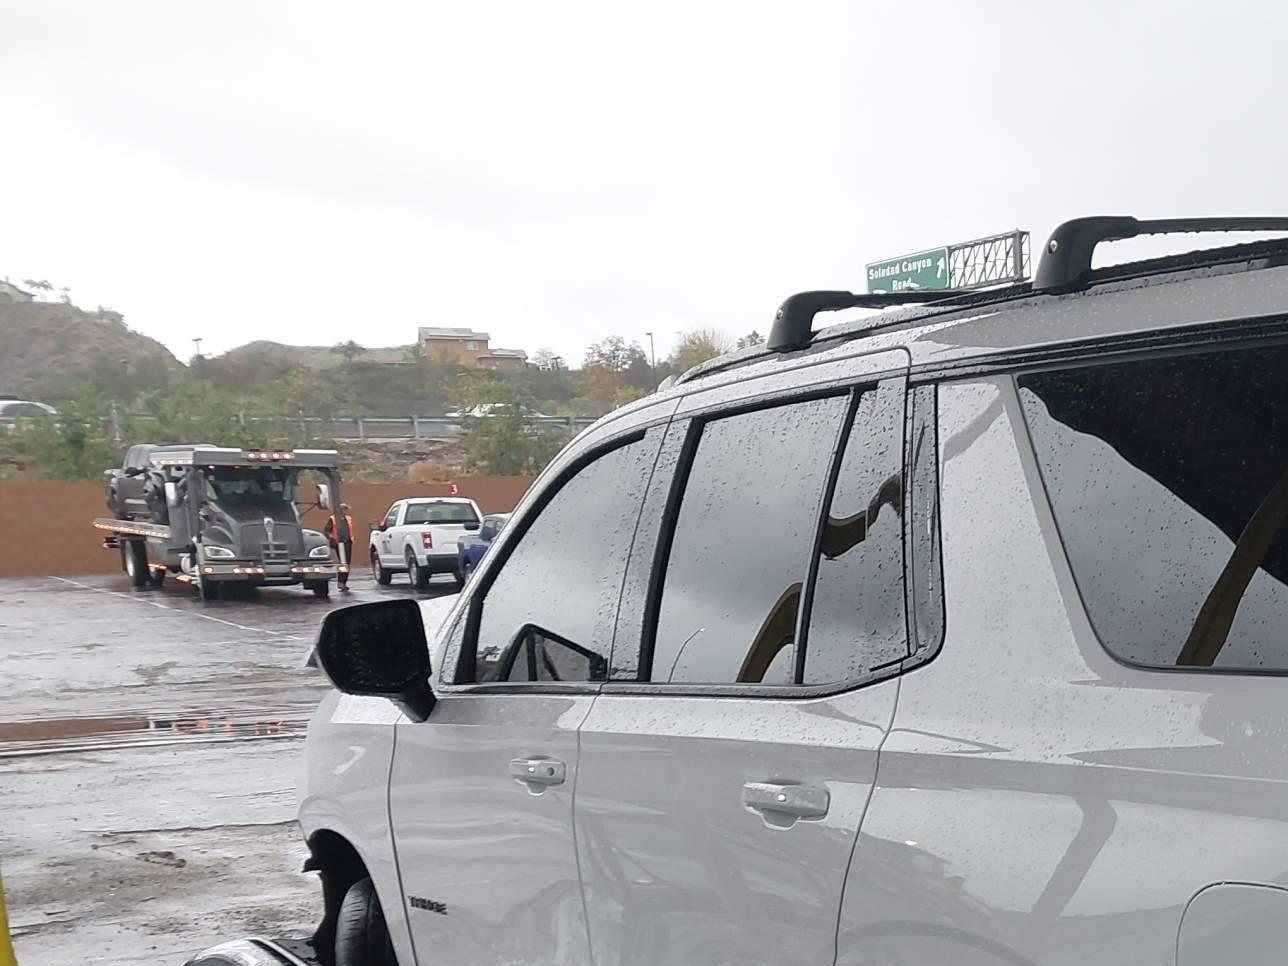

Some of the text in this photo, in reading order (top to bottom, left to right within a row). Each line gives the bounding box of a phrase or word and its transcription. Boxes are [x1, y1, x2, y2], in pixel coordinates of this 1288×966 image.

[869, 258, 932, 280] Soledad Canyon
[892, 277, 912, 291] Road
